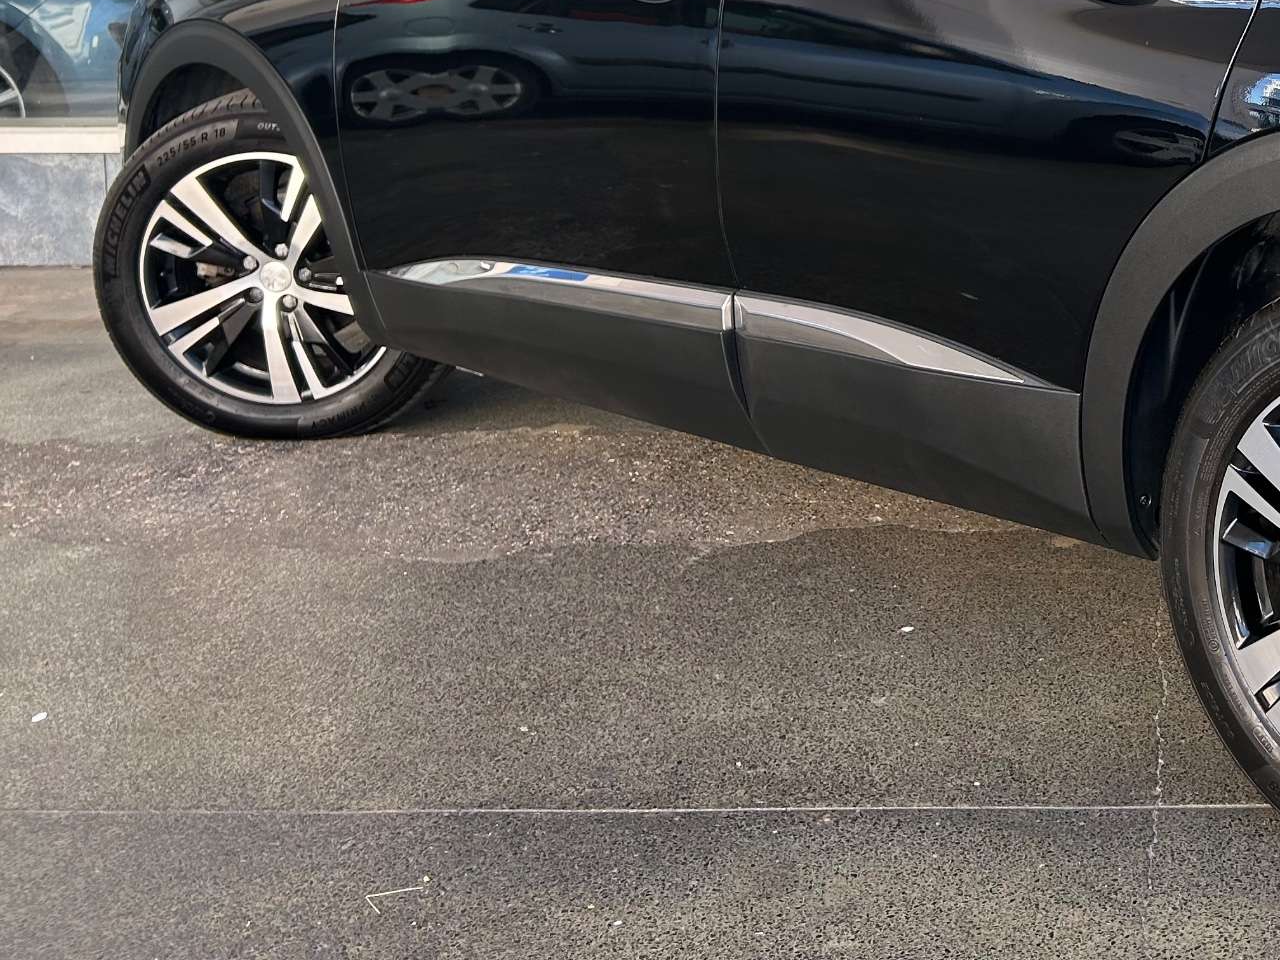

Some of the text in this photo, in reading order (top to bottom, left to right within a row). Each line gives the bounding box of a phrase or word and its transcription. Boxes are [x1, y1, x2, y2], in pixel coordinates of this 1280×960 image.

[157, 135, 197, 167] 225/55
[201, 132, 209, 142] R
[102, 168, 150, 279] MICHELIN
